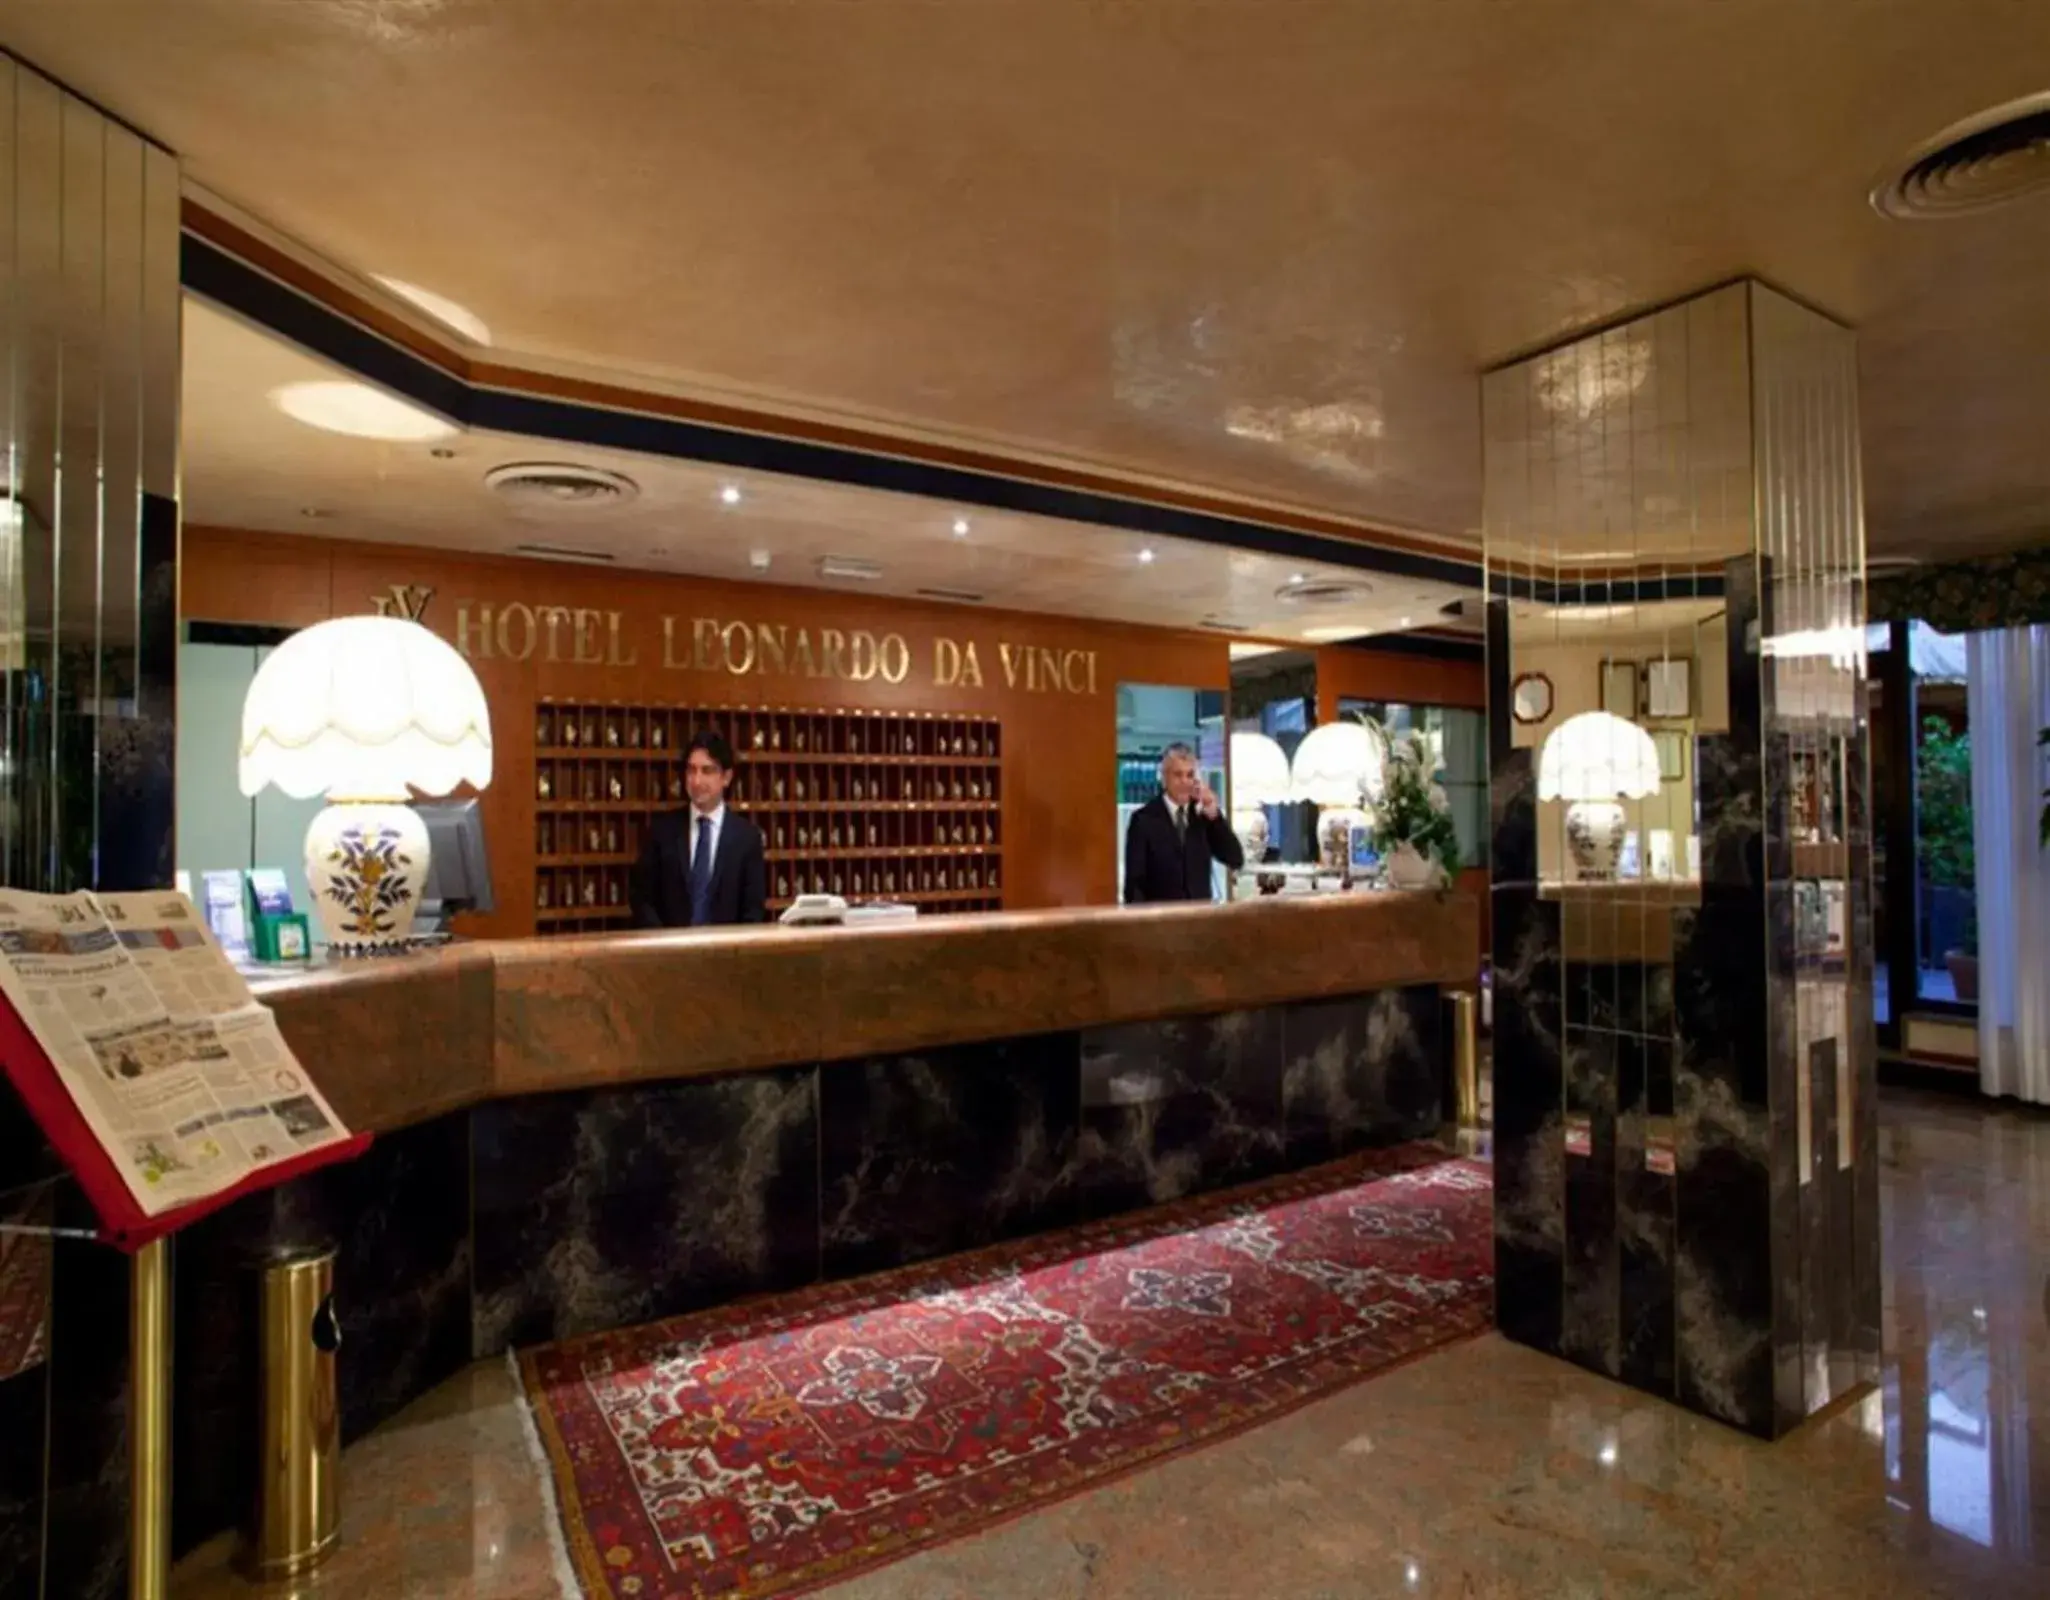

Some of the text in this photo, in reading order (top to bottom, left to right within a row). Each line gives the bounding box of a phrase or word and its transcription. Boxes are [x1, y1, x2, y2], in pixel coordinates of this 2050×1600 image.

[453, 598, 1099, 694] HOTEL LEONARDO DA VINCI
